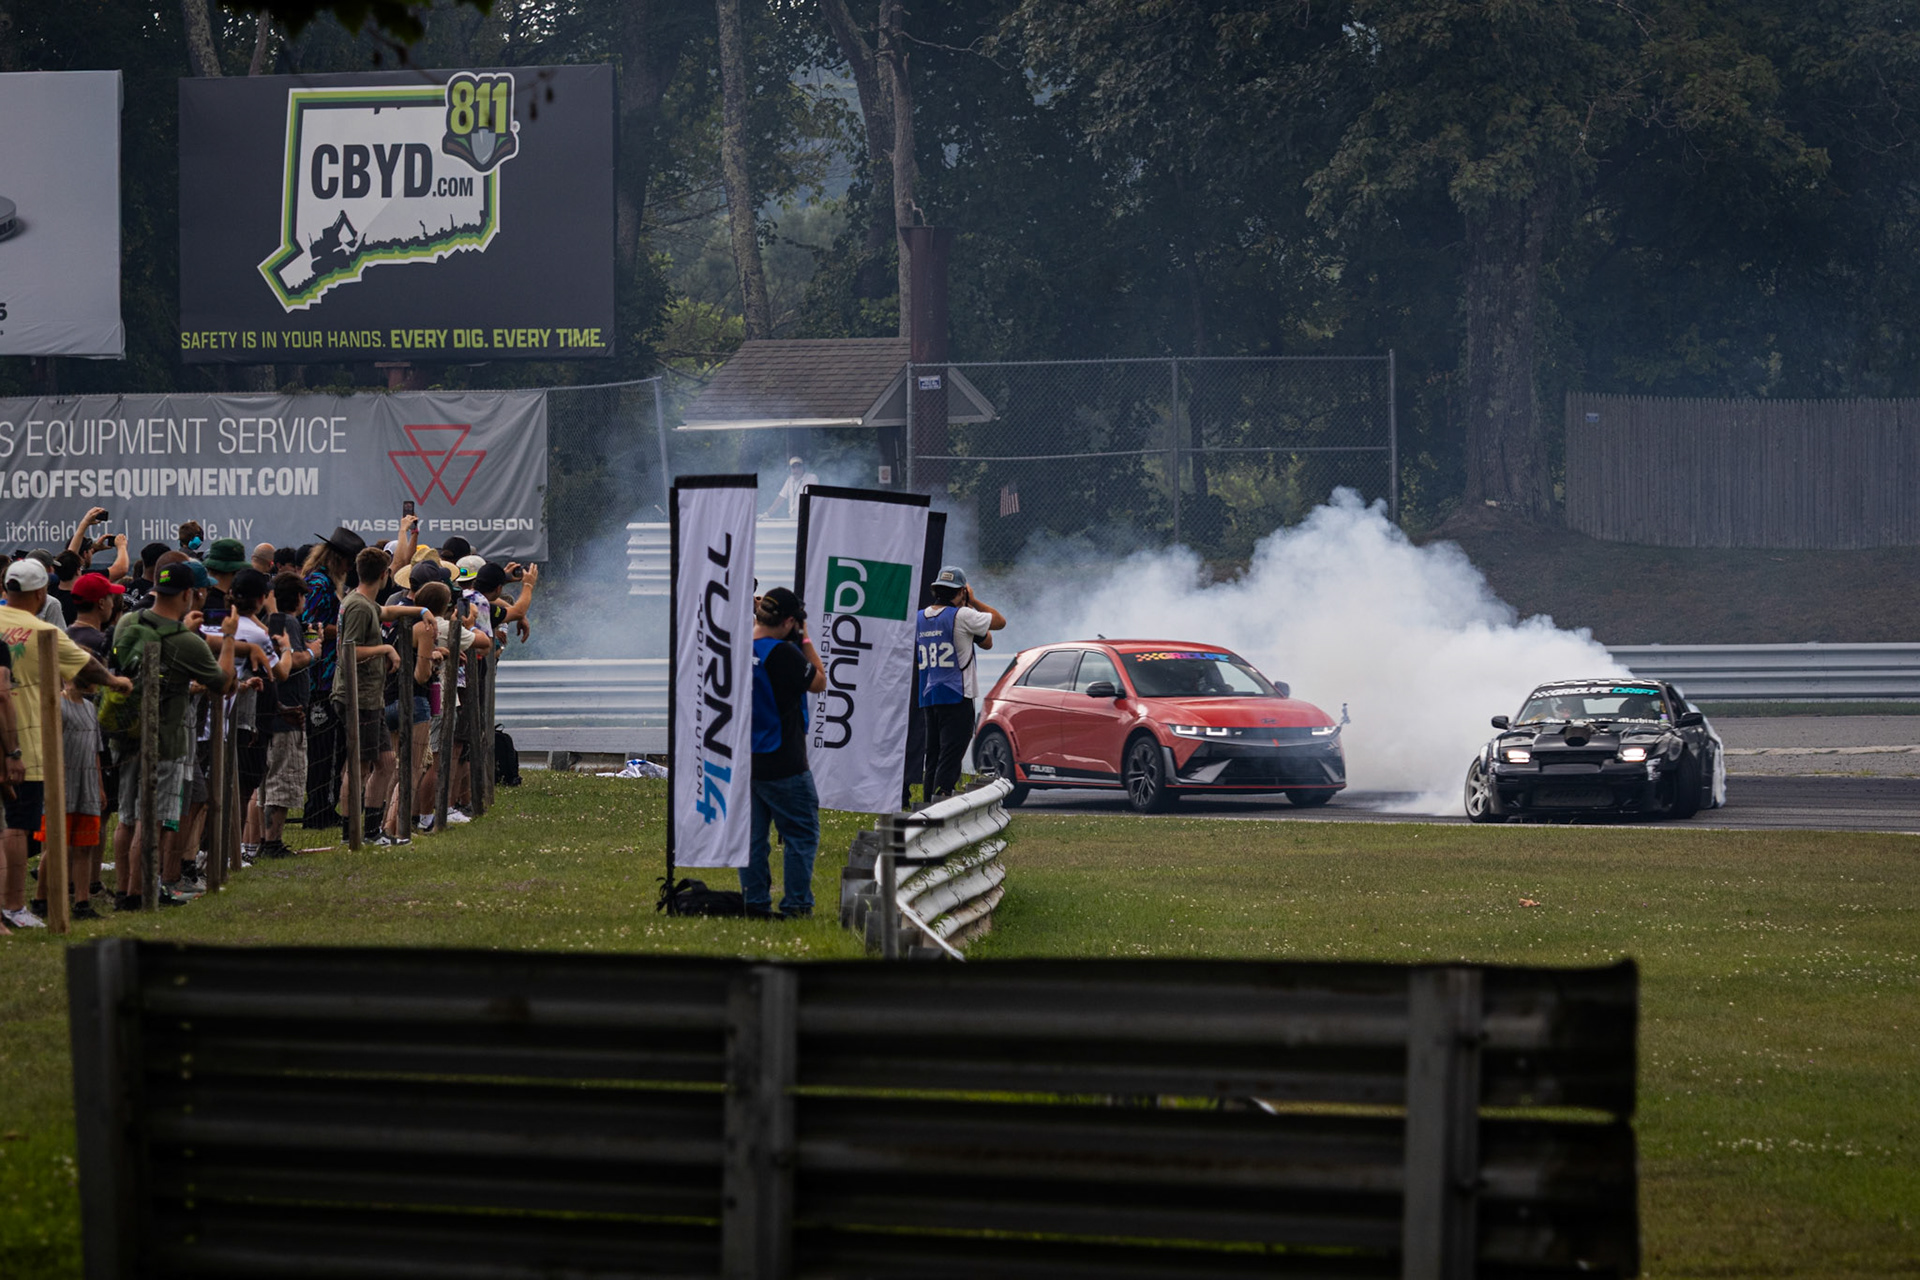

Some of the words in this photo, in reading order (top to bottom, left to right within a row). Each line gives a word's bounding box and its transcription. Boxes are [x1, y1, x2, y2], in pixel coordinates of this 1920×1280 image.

[450, 81, 508, 134] 811
[311, 143, 473, 200] CBYD.COM
[181, 331, 238, 349] SAFETY
[242, 331, 257, 349] IS
[262, 331, 277, 348] IN
[281, 331, 323, 348] YOUR
[327, 330, 386, 348] HANDS.
[390, 329, 448, 348] EVERY
[453, 329, 489, 348] DIG.
[493, 328, 551, 348] EVERY
[556, 328, 606, 347] TIME.
[26, 418, 208, 457] EQUIPMENT
[218, 416, 347, 454] SERVICE
[0, 467, 319, 500] .GOFFSEQUIPMENT.COM
[141, 519, 223, 541] Hillsle,
[229, 519, 254, 540] NY
[342, 518, 424, 532] MASSY
[428, 518, 534, 531] FERGUSON
[823, 558, 873, 749] radium
[1552, 687, 1613, 696] GRIDLIFE
[1612, 687, 1660, 696] DRIFT
[695, 628, 704, 796] DISTRIBUTION
